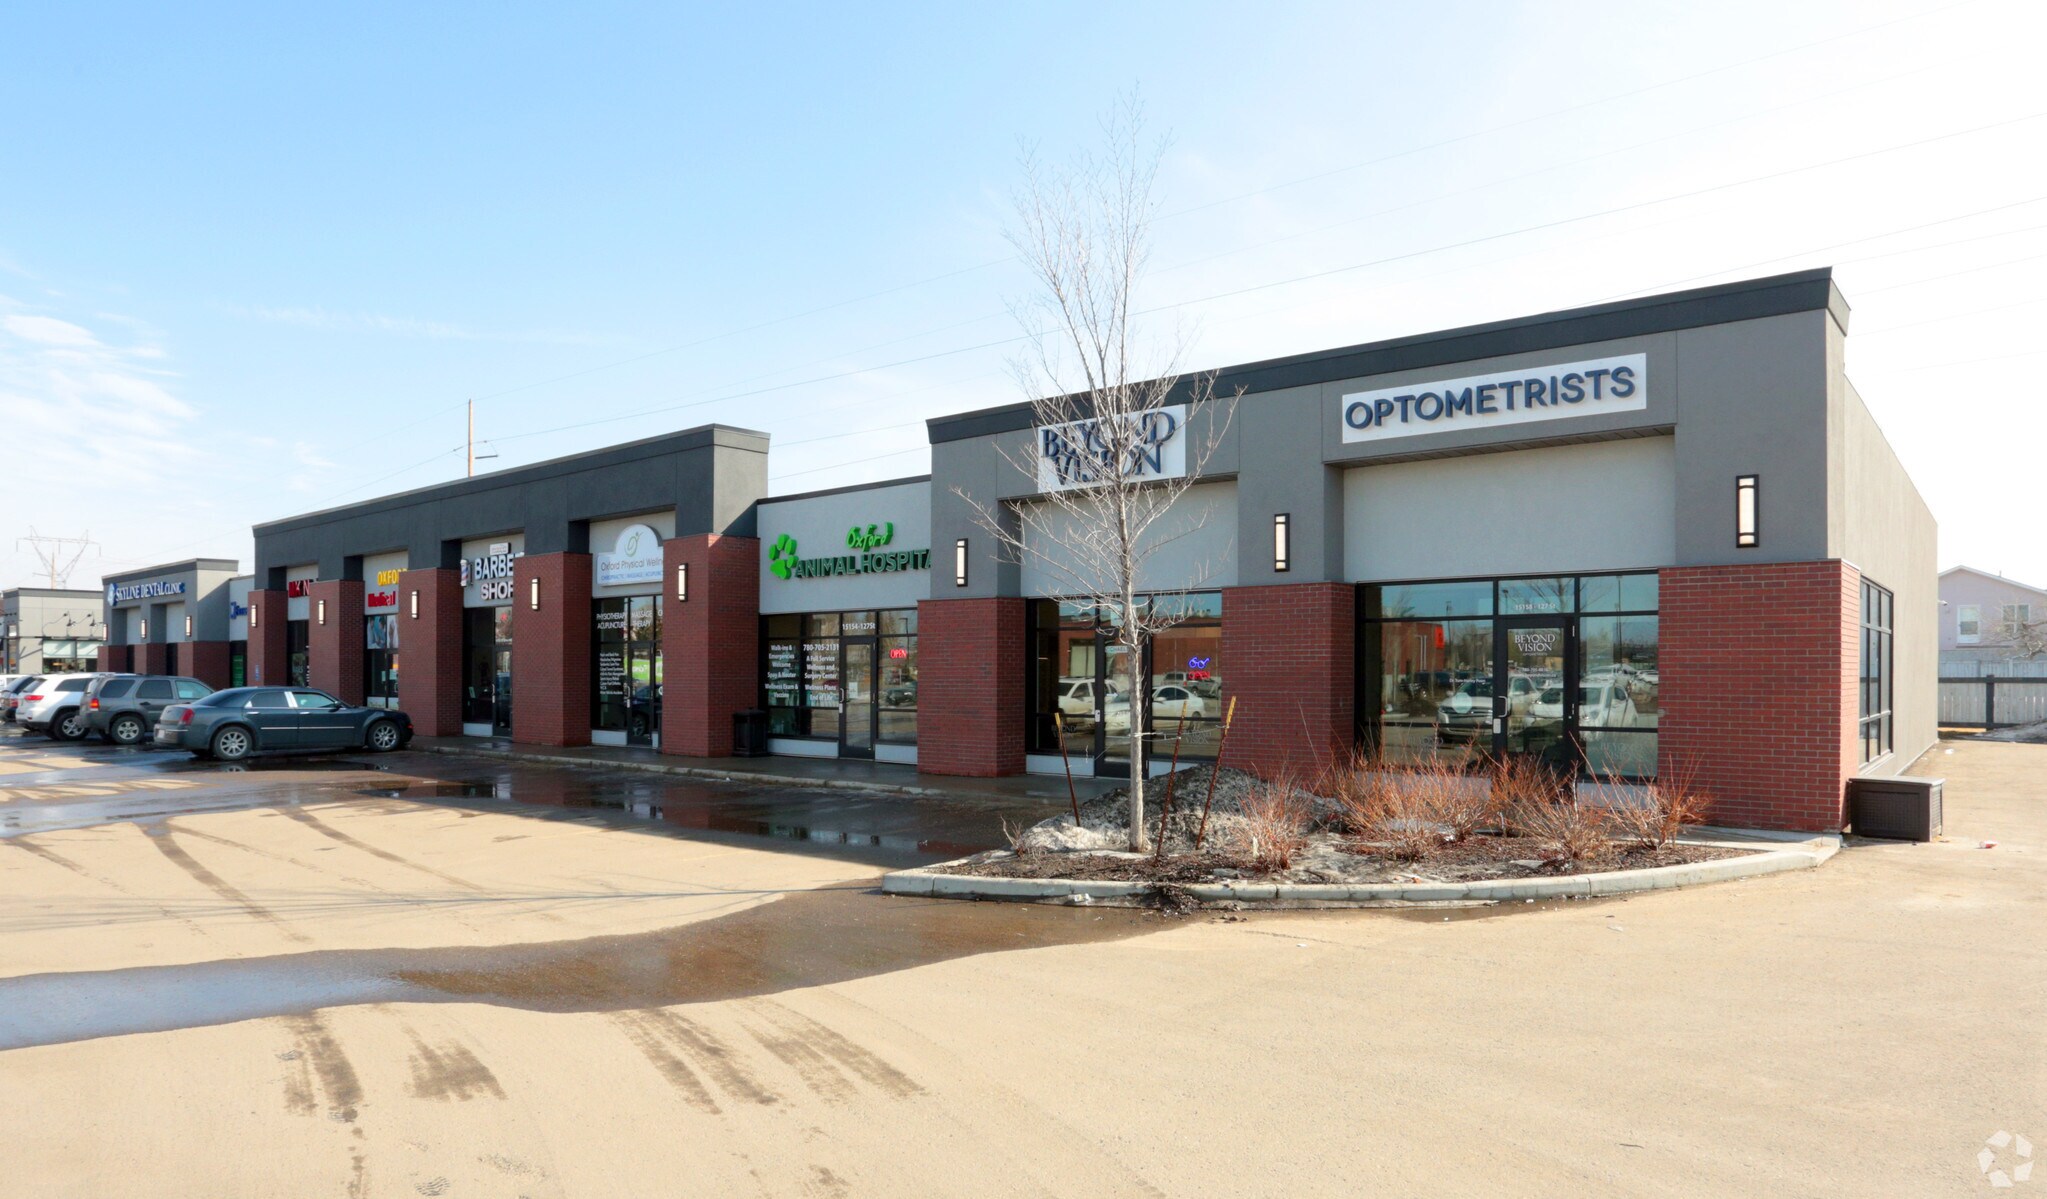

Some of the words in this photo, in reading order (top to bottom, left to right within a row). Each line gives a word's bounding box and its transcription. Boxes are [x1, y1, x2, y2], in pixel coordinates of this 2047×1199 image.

[1345, 366, 1636, 429] OPTOMETRISTS
[846, 522, 893, 552] Oxford
[475, 552, 524, 580] BARBE
[601, 562, 620, 571] Oxford
[795, 556, 860, 578] ANIMAL
[860, 549, 931, 573] HOSPITA
[377, 568, 407, 586] OXFO
[116, 585, 140, 601] SKYLINE
[140, 582, 164, 598] DENTAL
[164, 582, 185, 595] CLINIC
[803, 643, 840, 652] 780-705-2131
[1514, 634, 1556, 643] BEYOND
[1518, 643, 1552, 652] VISION
[889, 649, 907, 659] OPEN
